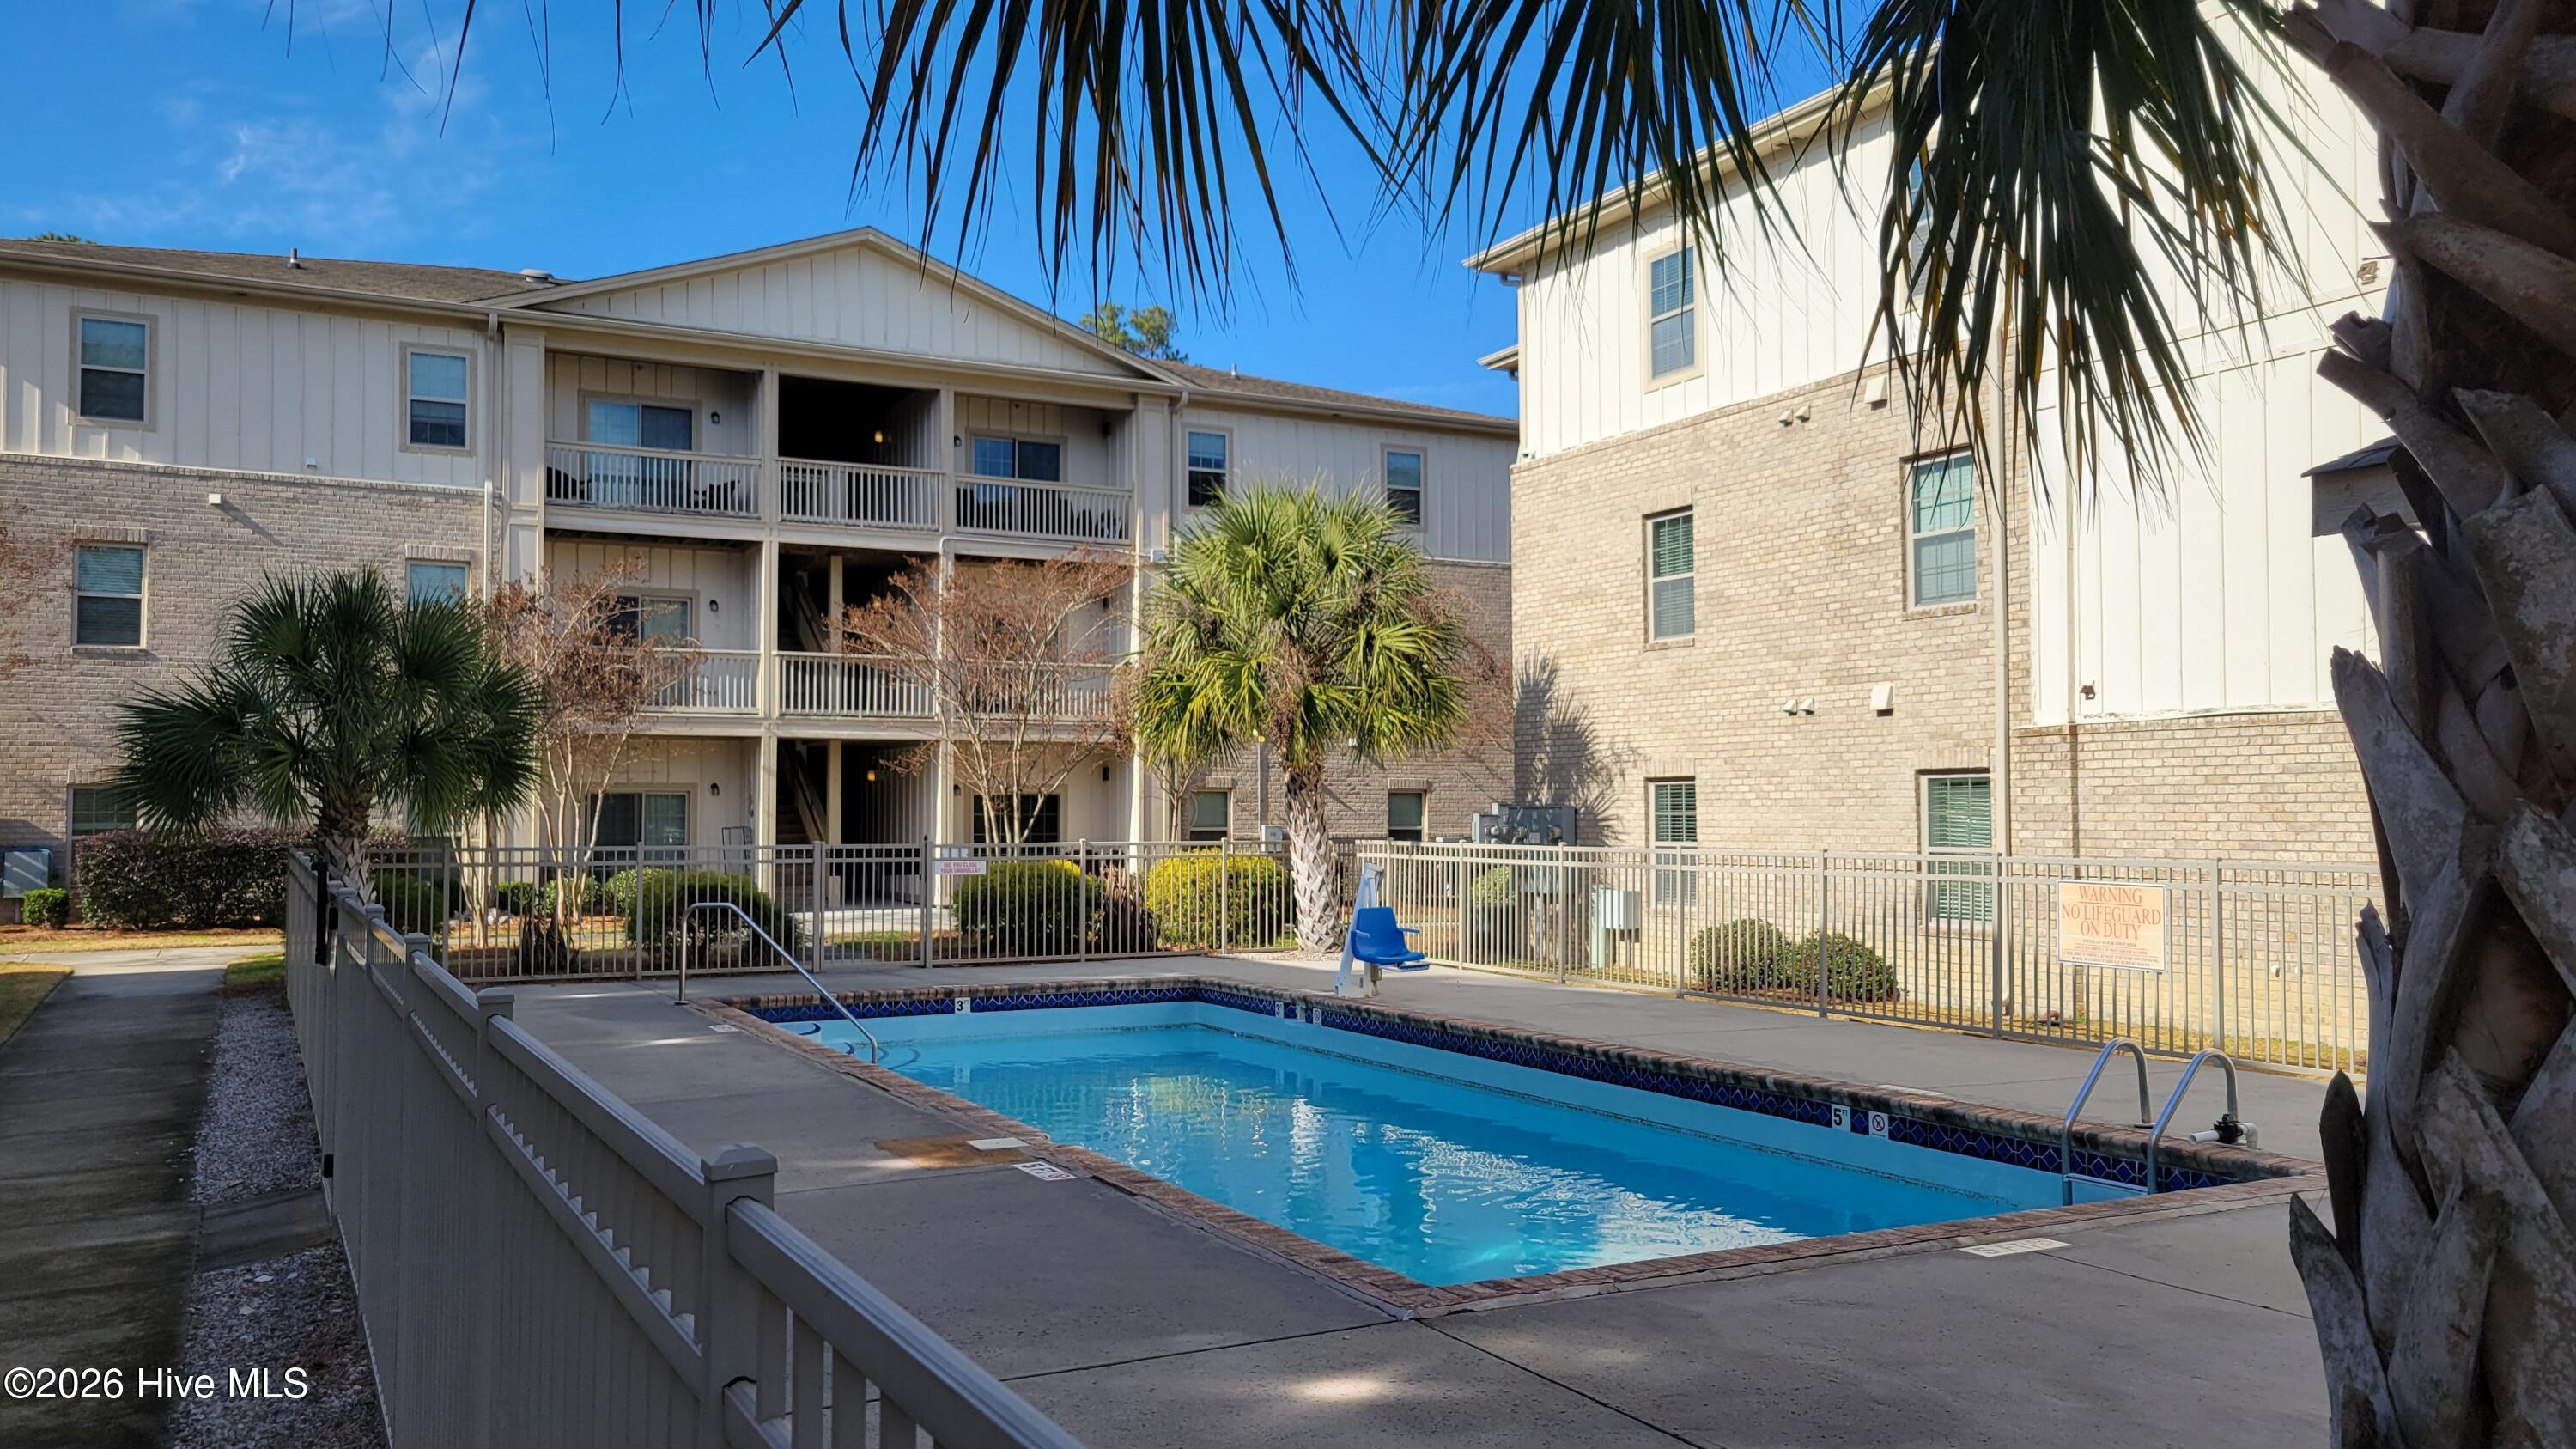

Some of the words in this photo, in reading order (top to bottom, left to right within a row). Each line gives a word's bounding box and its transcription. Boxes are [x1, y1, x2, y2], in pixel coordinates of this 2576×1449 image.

[2079, 886, 2142, 904] WARNING
[2062, 904, 2081, 920] NO
[2084, 904, 2161, 925] LIFEGUARD
[2081, 921, 2099, 936] ON
[2104, 922, 2141, 940] DUTY
[957, 1000, 963, 1012] 3
[1833, 1108, 1843, 1127] 5
